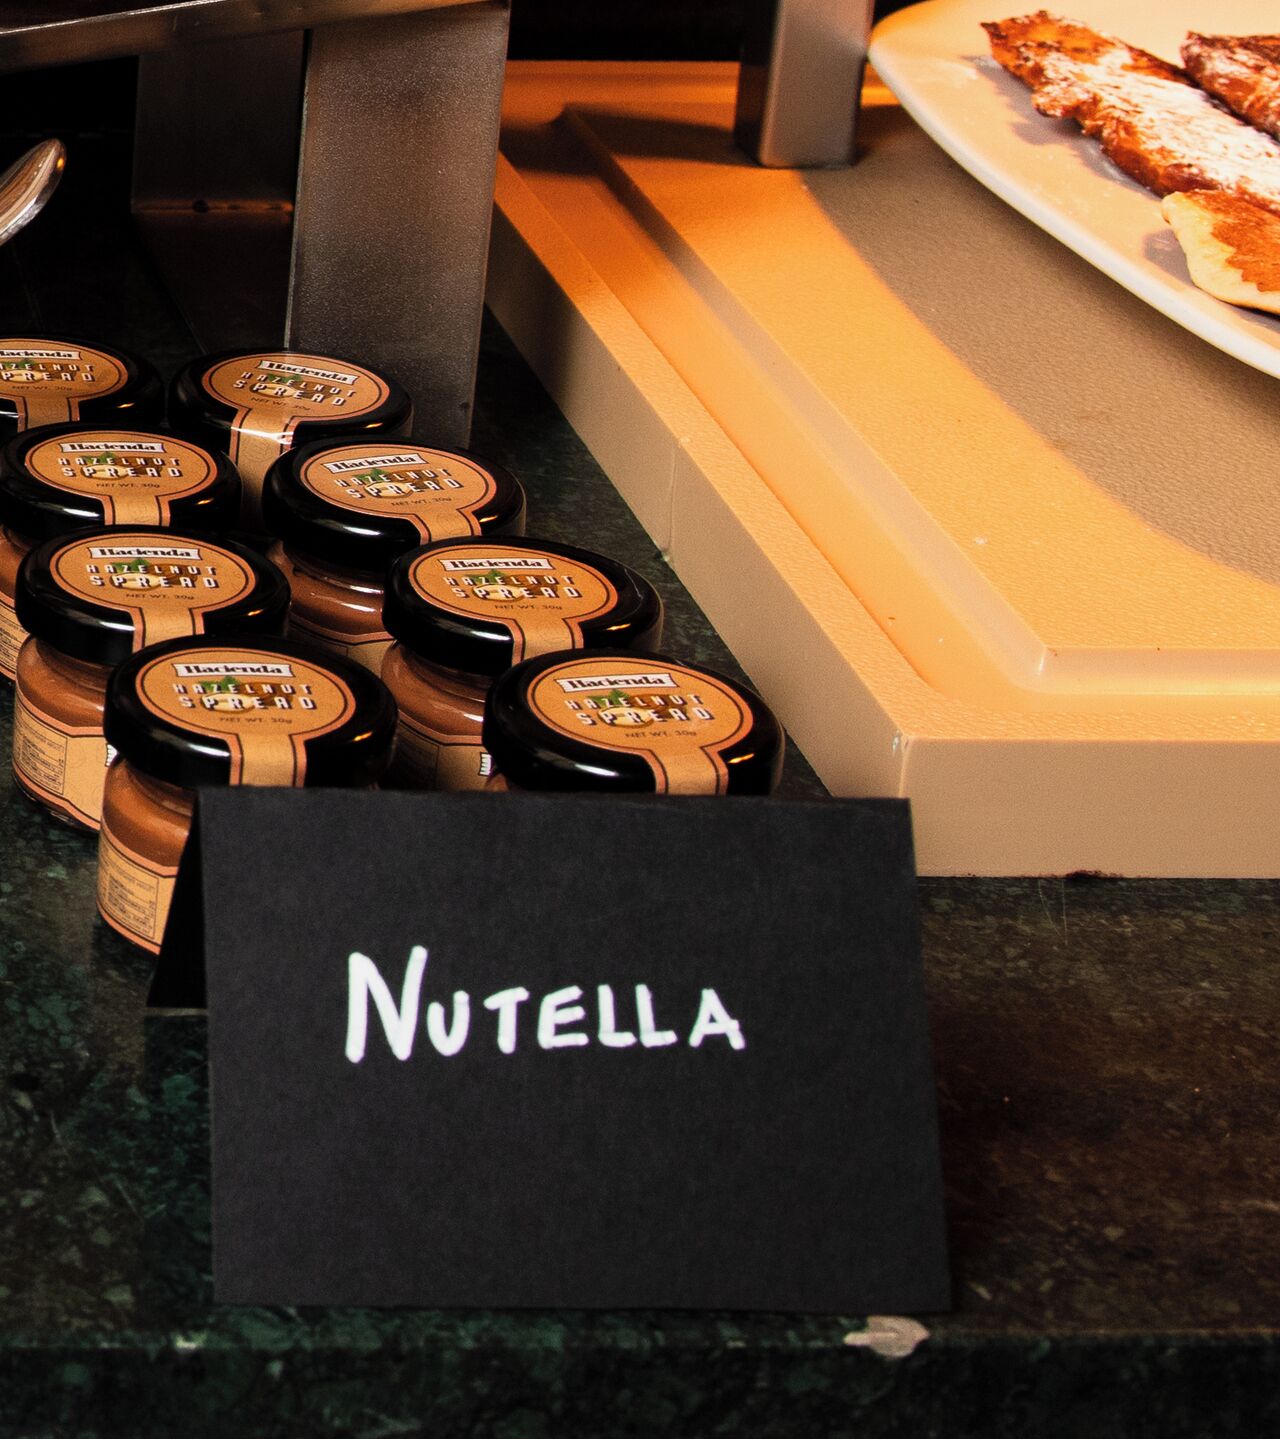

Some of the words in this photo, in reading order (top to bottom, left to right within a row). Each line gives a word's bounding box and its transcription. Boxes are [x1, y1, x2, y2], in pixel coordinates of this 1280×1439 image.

[268, 363, 348, 381] Hacienda
[241, 372, 356, 397] HAZELNUT
[233, 380, 347, 406] SPREAD
[58, 458, 181, 466] HAZELNUT
[332, 456, 416, 470] Hacienda
[63, 467, 182, 477] SPREAD
[334, 468, 453, 487] HAZELNUT
[345, 479, 464, 498] SPREAD
[98, 548, 191, 556] Hacienda
[86, 565, 216, 575] HAZELNUT
[450, 560, 542, 568] Hacienda
[90, 576, 219, 588] SPREAD
[444, 576, 575, 586] HAZELNUT
[452, 587, 583, 598] SPREAD
[184, 665, 282, 674] Hacienda
[173, 683, 312, 694] HAZELNUT
[568, 676, 666, 689] Hacienda
[179, 696, 317, 709] SPREAD
[565, 694, 704, 710] HAZELNUT
[576, 707, 715, 725] SPREAD
[345, 945, 746, 1063] NUTELLA
